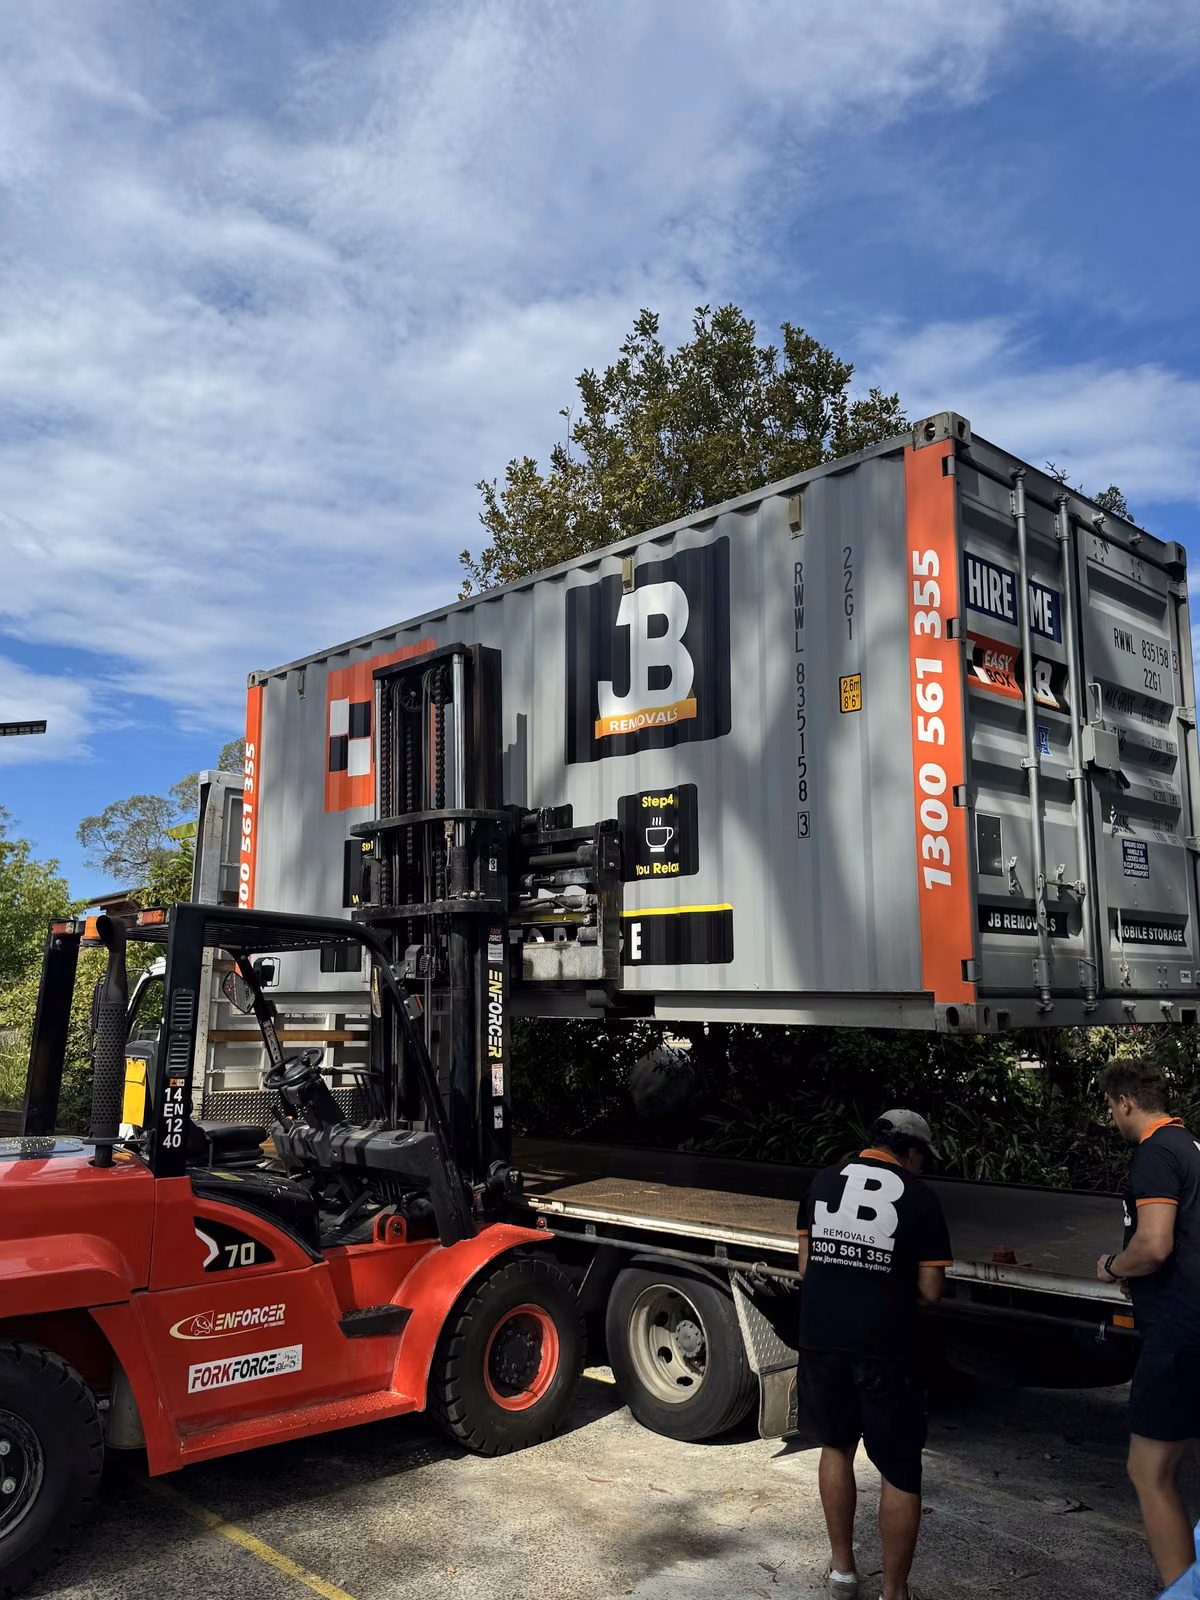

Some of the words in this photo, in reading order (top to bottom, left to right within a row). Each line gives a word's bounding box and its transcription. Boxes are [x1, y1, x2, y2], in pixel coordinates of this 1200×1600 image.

[842, 546, 854, 640] 22G1
[912, 549, 942, 638] 355
[967, 558, 1014, 619] HIRE
[1028, 584, 1054, 636] ME
[794, 562, 804, 653] RWWL
[597, 581, 695, 719] JB
[985, 650, 1012, 672] EASY
[1113, 627, 1136, 655] RWWL
[1141, 639, 1169, 669] 835158
[987, 668, 1015, 689] BOX
[1143, 668, 1162, 694] 22G1
[914, 658, 946, 746] 561
[609, 707, 678, 732] REMOVALS
[796, 663, 808, 802] 835158
[244, 742, 255, 794] 355
[641, 793, 674, 809] Step4
[241, 803, 253, 853] 561
[918, 762, 952, 890] 1300
[636, 864, 650, 876] You
[653, 862, 680, 874] Relax
[988, 912, 1002, 929] JB
[1148, 928, 1183, 942] STORAGE
[488, 969, 503, 1059] ENFORCER
[164, 1087, 183, 1102] 14
[163, 1103, 184, 1117] EN
[165, 1118, 183, 1133] 12
[162, 1133, 182, 1149] 40
[814, 1163, 905, 1238] JB
[823, 1227, 876, 1244] REMOVALS
[225, 1241, 255, 1268] 70
[811, 1255, 892, 1273] www.jbremovals.sydney
[812, 1241, 836, 1254] 1300
[840, 1245, 862, 1259] 561
[867, 1249, 892, 1264] 355
[215, 1303, 286, 1331] ENFORCER
[191, 1353, 278, 1389] FORKFORCE
